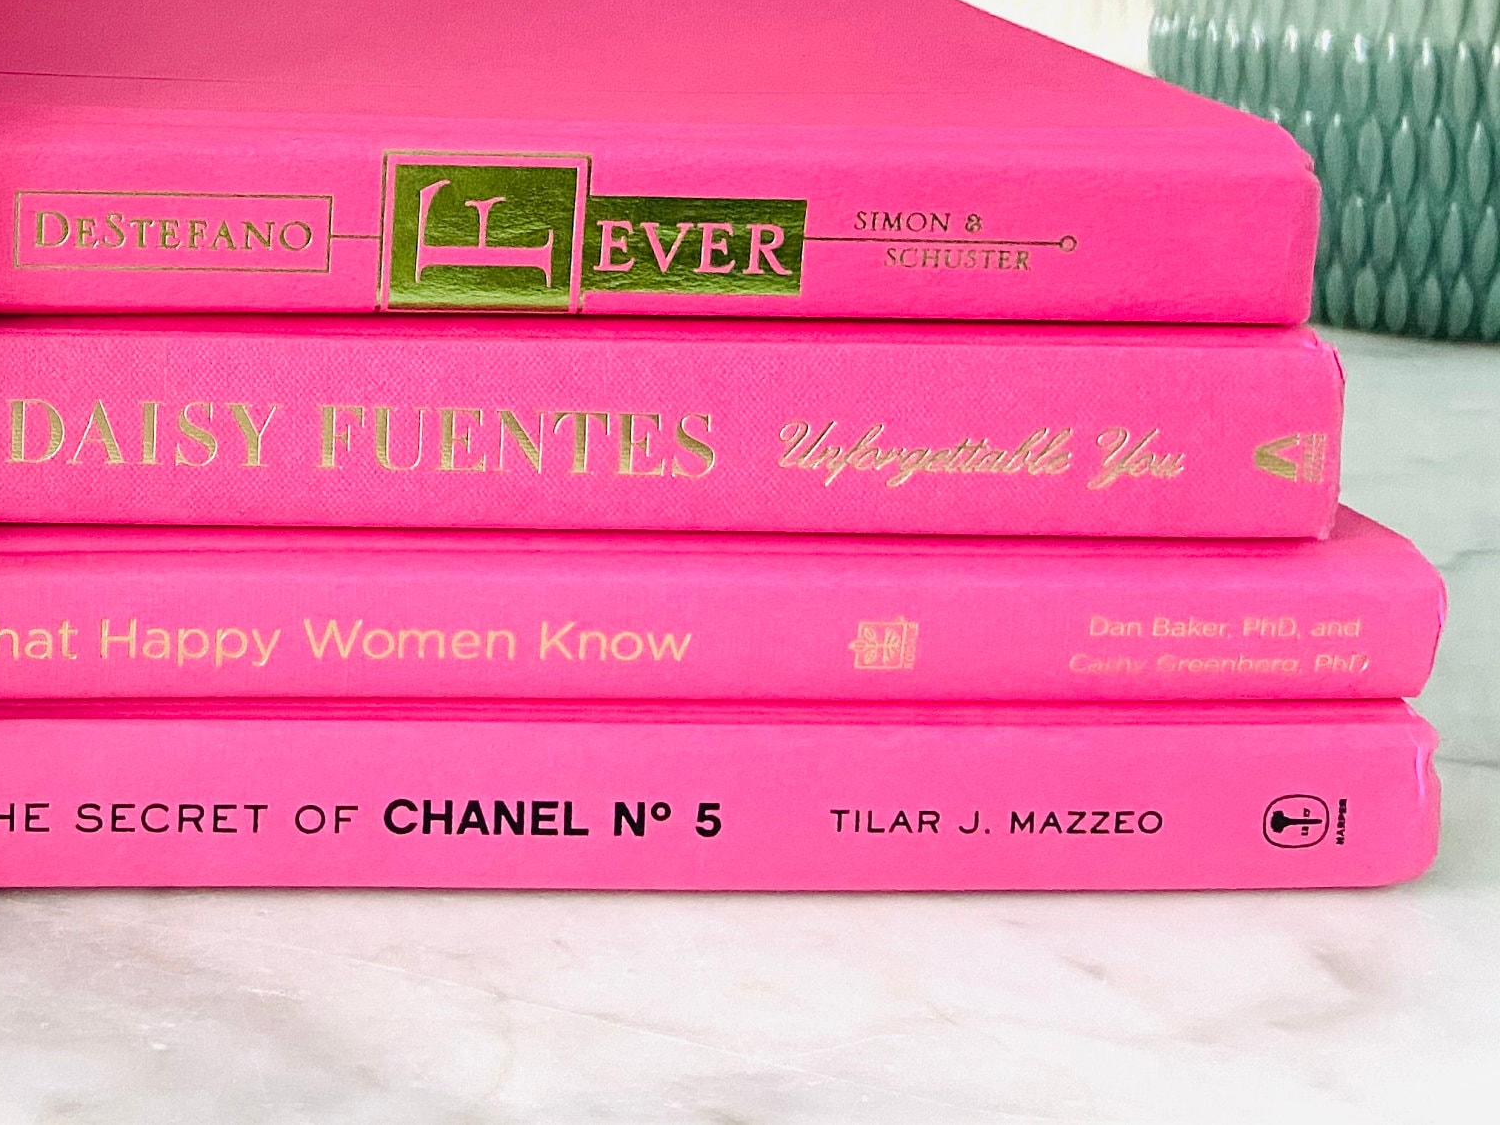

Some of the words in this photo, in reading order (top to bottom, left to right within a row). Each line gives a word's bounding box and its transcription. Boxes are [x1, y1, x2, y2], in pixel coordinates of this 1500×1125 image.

[854, 211, 951, 232] SIMON
[965, 213, 983, 233] &
[884, 247, 1031, 271] SCHUSTER
[5, 398, 282, 469] DAISY
[316, 404, 718, 478] FUENTES
[778, 420, 1073, 488] Unforgettable
[1086, 427, 1185, 490] You
[100, 619, 282, 668] Happy
[303, 619, 516, 661] Women
[539, 622, 692, 662] Know
[1089, 616, 1142, 638] Dan
[1152, 616, 1232, 640] Baker,
[1310, 618, 1362, 639] and
[76, 803, 268, 835] SECRET
[295, 804, 359, 835] OF
[383, 799, 589, 837] CHANEL
[695, 802, 723, 837] 5
[830, 809, 941, 835] TILAR
[959, 810, 991, 835] J.
[1010, 810, 1164, 835] MAZZEO
